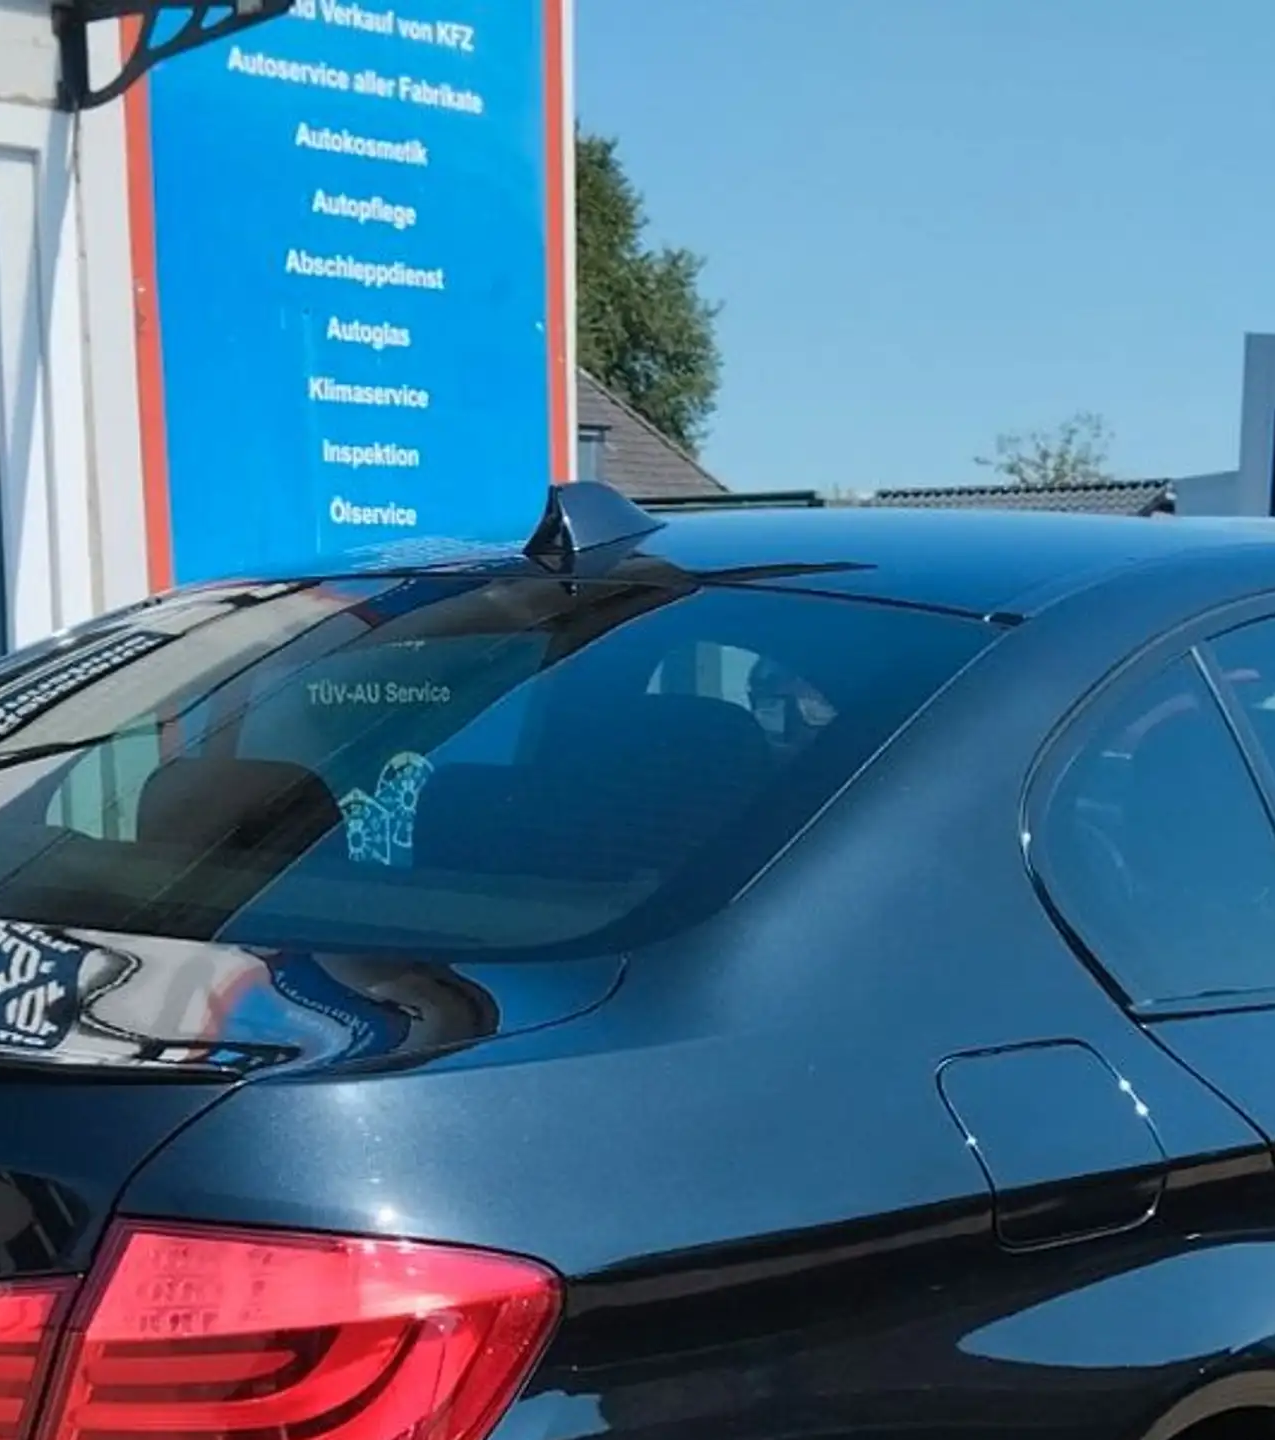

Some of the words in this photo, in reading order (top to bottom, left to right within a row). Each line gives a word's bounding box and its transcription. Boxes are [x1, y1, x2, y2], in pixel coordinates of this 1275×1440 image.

[320, 0, 394, 35] Verkauf
[397, 17, 434, 43] von
[437, 20, 475, 52] KFZ
[228, 46, 350, 91] Autoservice
[353, 69, 396, 99] aller
[399, 77, 483, 115] Fabrikate
[295, 122, 428, 165] Autokosmetik
[312, 189, 417, 230] Autopflege
[285, 248, 445, 291] Abschleppdienst
[327, 316, 411, 350] Autoglas
[308, 376, 429, 409] Klimaservice
[323, 438, 420, 469] Inspektion
[330, 496, 417, 527] Ölservice
[307, 680, 380, 704] TÜV-AU
[385, 681, 451, 703] Service
